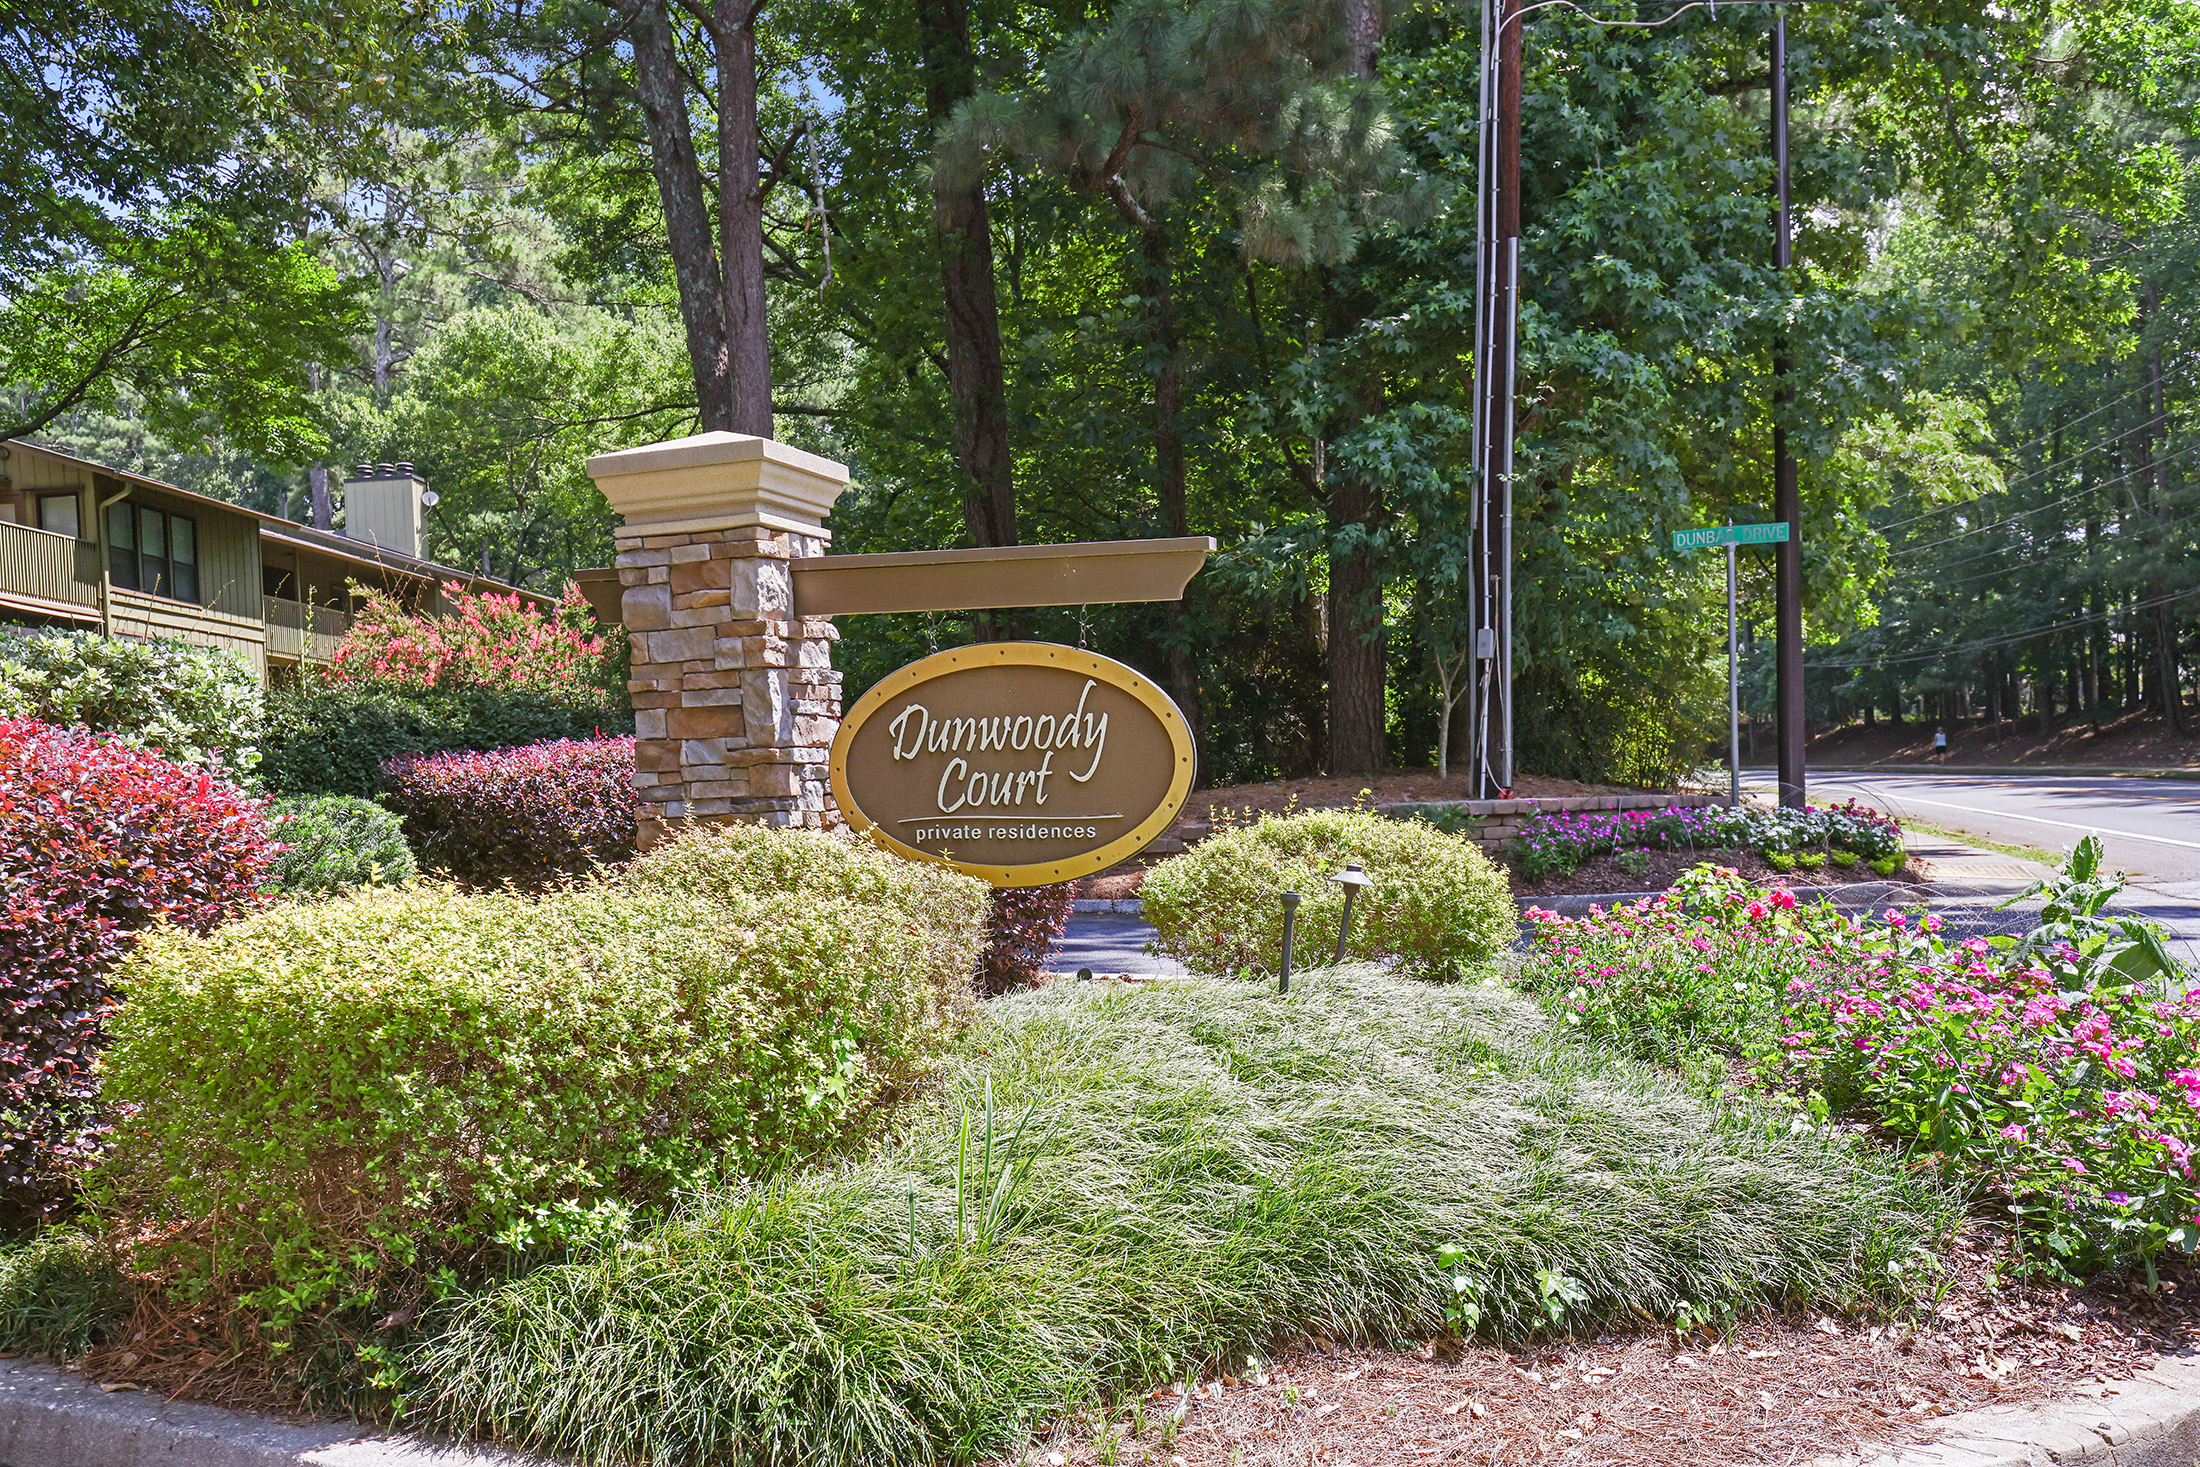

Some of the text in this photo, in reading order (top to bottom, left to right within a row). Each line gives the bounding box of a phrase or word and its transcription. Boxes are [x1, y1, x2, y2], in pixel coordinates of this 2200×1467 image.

[1676, 526, 1785, 547] DUNBAR DRIVE
[889, 680, 1108, 782] Dunwoody
[937, 751, 1054, 813] Court
[916, 824, 1097, 843] private residences
